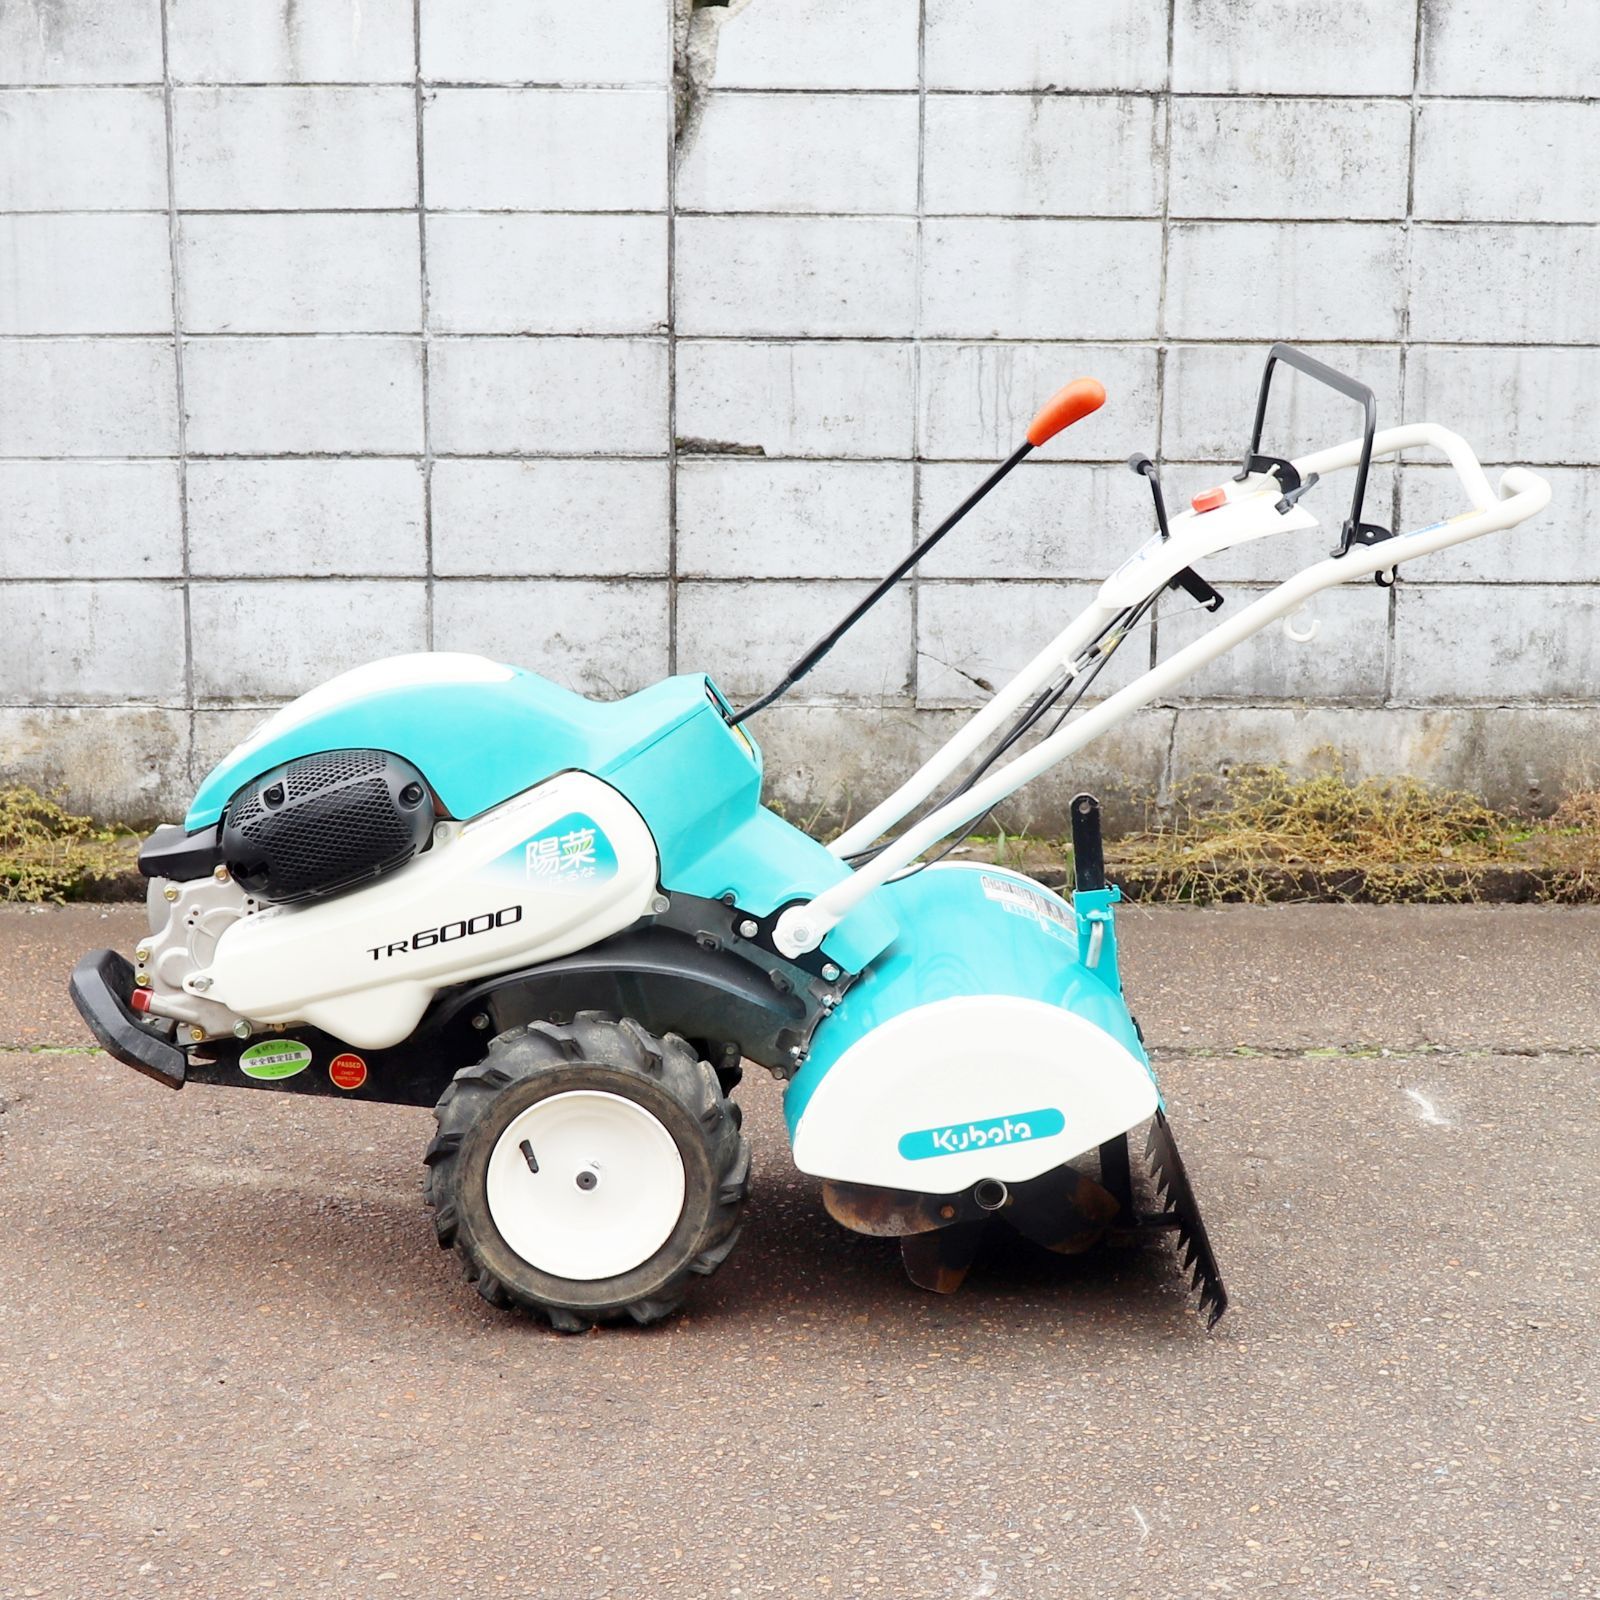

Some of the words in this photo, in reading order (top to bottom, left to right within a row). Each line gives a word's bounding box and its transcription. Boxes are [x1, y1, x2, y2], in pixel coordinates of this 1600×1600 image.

[525, 827, 596, 881] 陽菜
[366, 905, 522, 960] TR6000
[337, 1061, 361, 1069] PASSED
[932, 1119, 1032, 1152] Kubota
